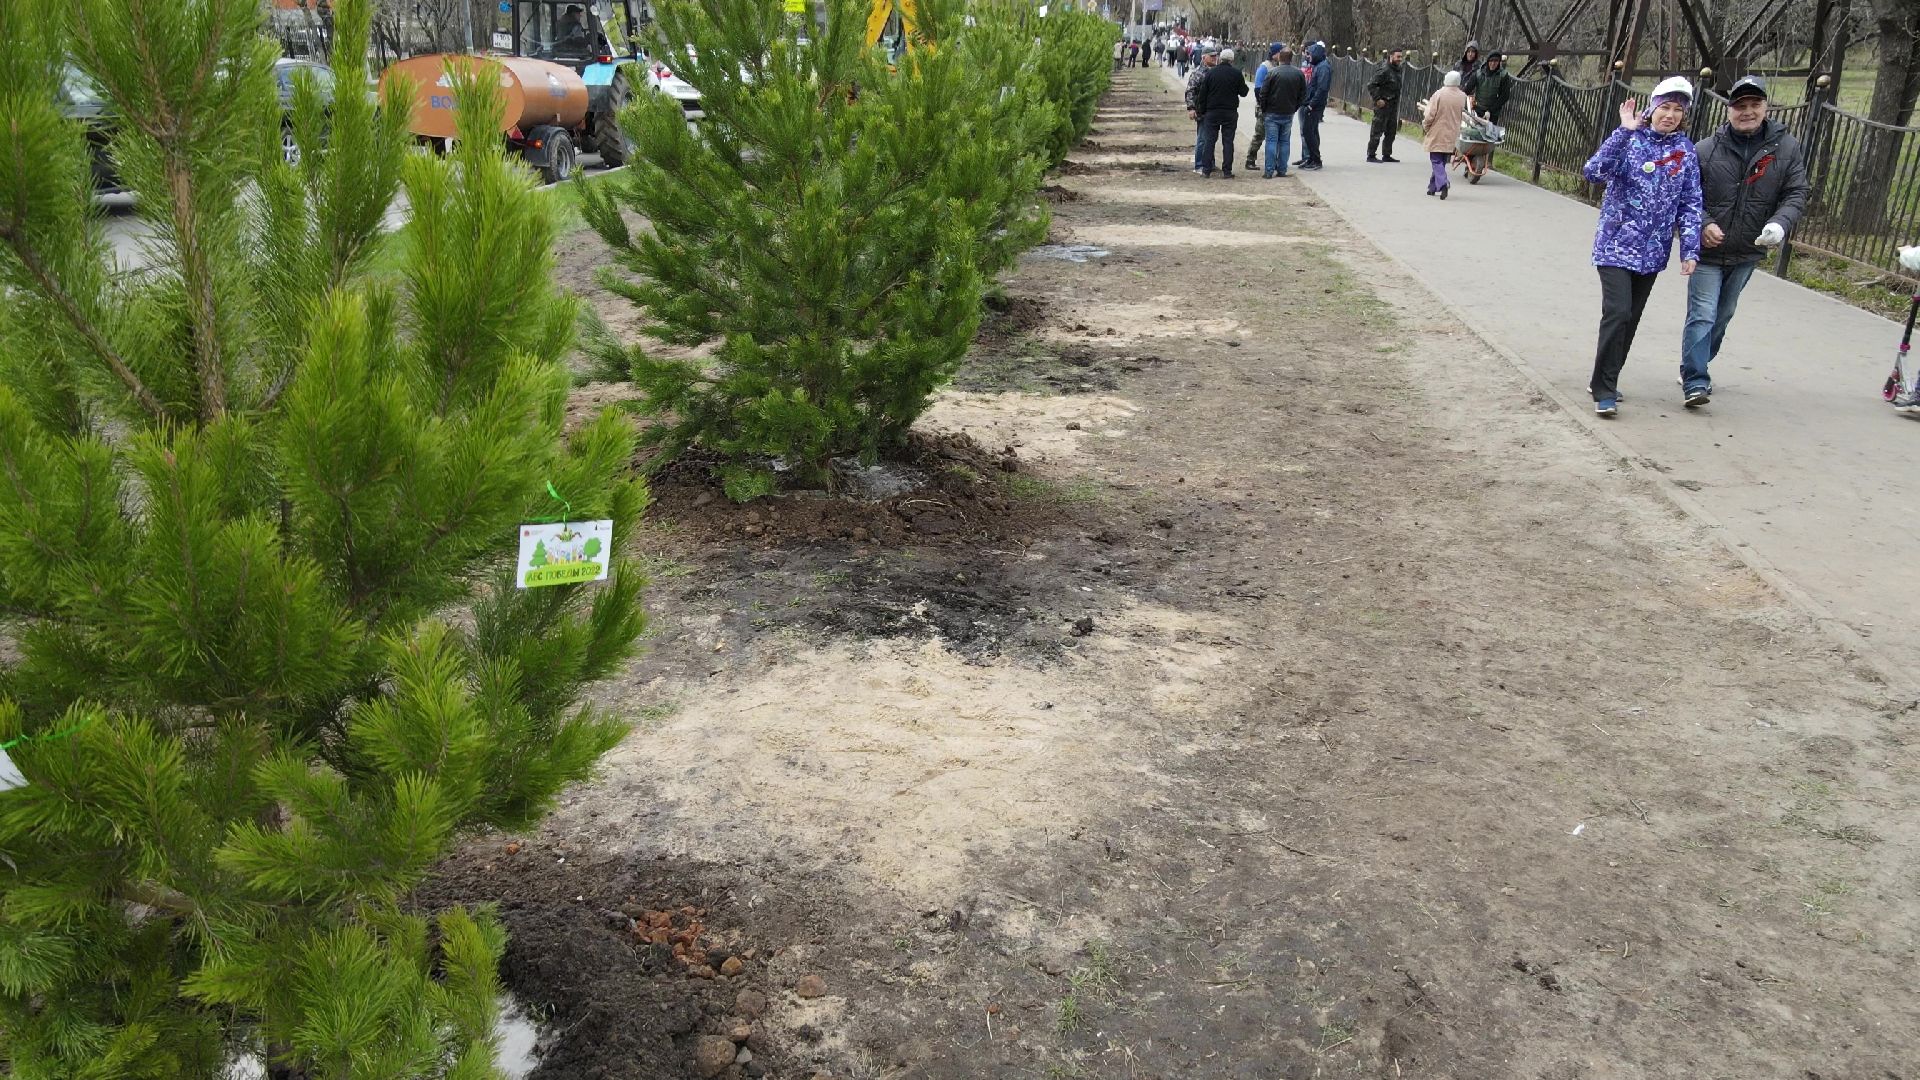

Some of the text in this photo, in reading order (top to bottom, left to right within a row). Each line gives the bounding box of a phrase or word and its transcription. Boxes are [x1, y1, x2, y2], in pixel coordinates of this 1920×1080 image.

[527, 564, 601, 582] ЛЕС ПОБЕДЫ 2022
